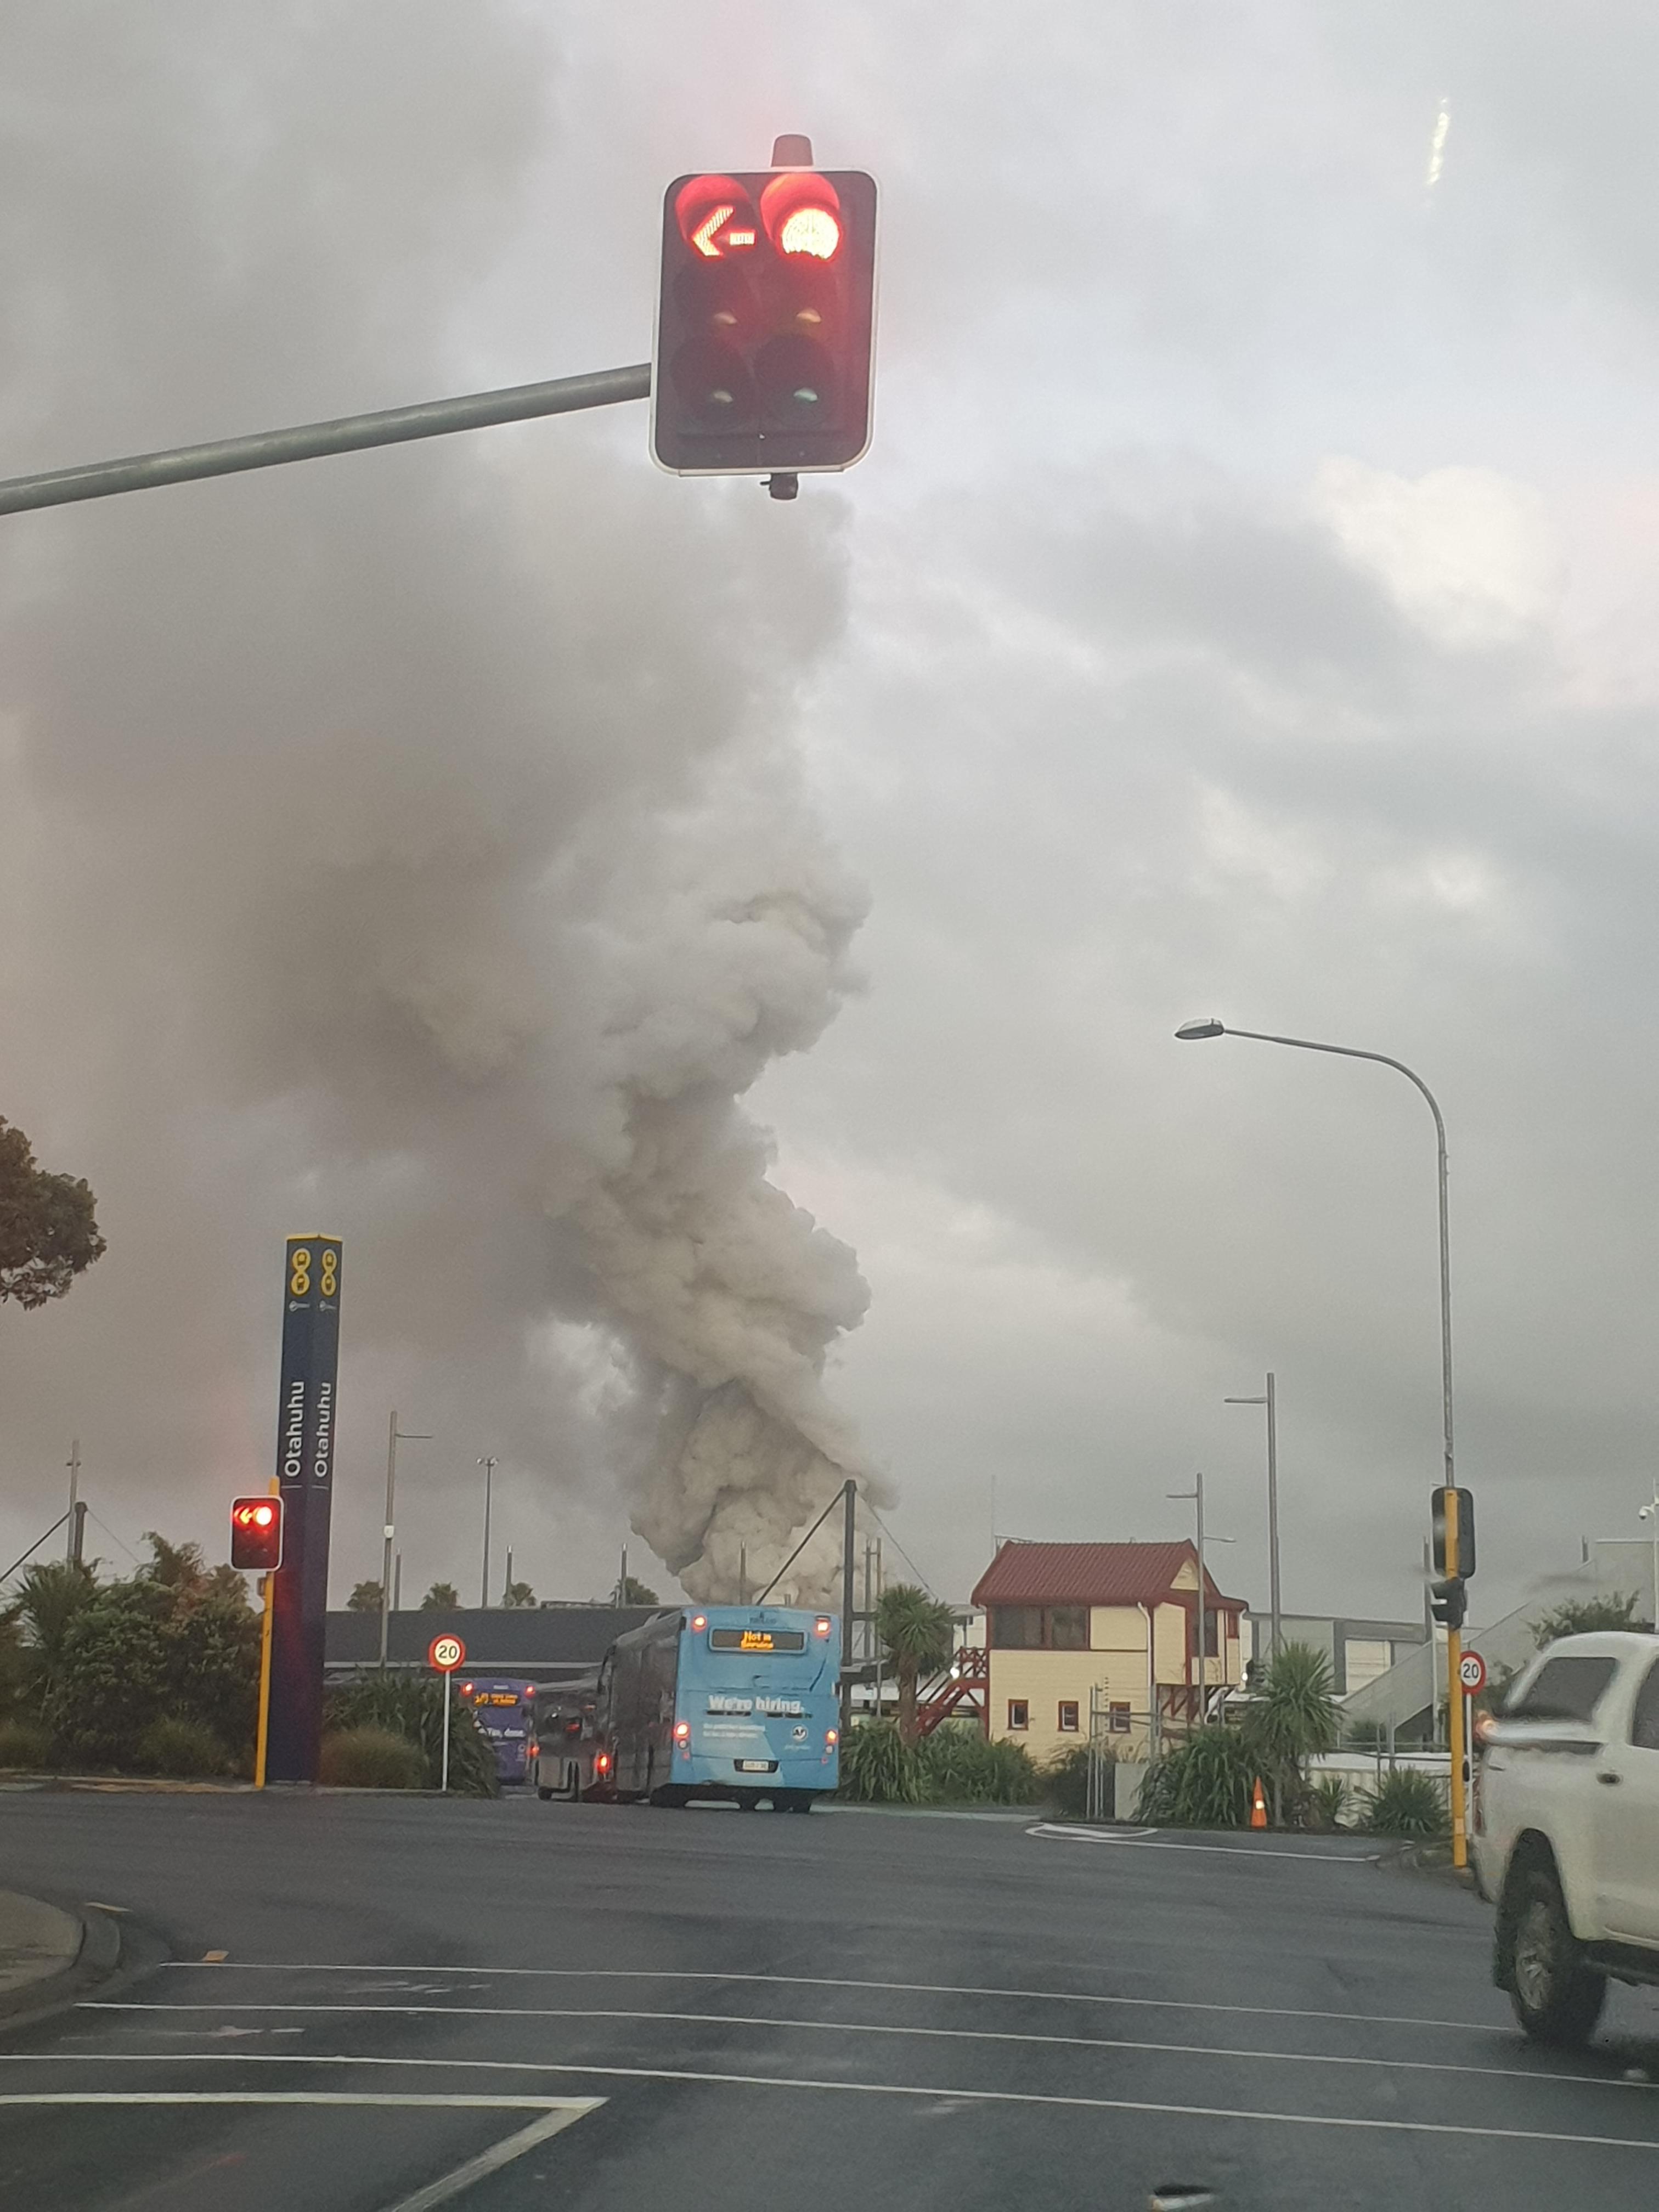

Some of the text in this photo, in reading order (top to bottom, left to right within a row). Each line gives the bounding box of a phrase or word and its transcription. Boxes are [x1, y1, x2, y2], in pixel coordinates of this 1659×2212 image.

[284, 1381, 304, 1477] Otahuhu
[314, 1383, 331, 1477] Otahuhu
[439, 1645, 458, 1659] 20
[1463, 1663, 1479, 1679] 20
